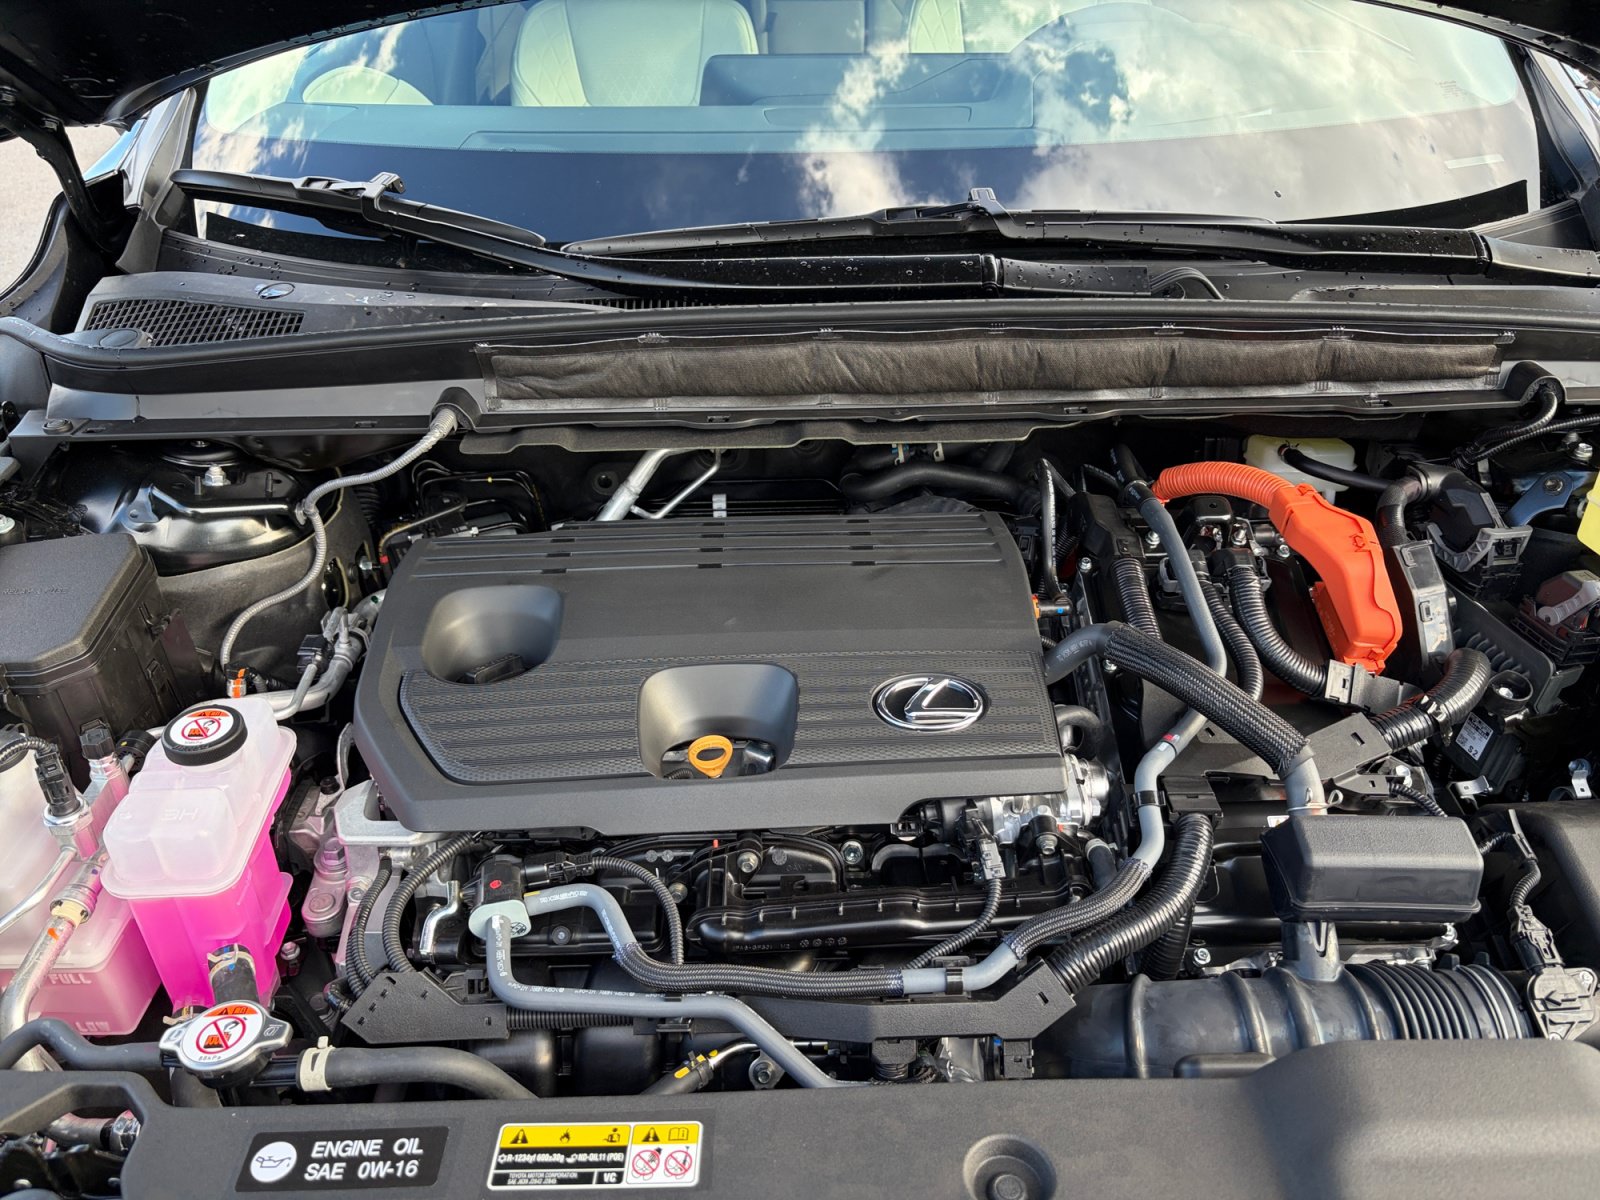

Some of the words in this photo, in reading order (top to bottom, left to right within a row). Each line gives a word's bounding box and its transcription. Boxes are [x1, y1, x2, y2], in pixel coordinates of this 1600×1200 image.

[48, 973, 92, 985] FULL
[75, 1021, 110, 1032] LOW
[311, 1139, 383, 1158] ENGINE
[393, 1137, 424, 1155] OIL
[304, 1162, 346, 1181] SAE
[357, 1160, 418, 1179] 0W-16
[603, 1172, 617, 1183] VC
